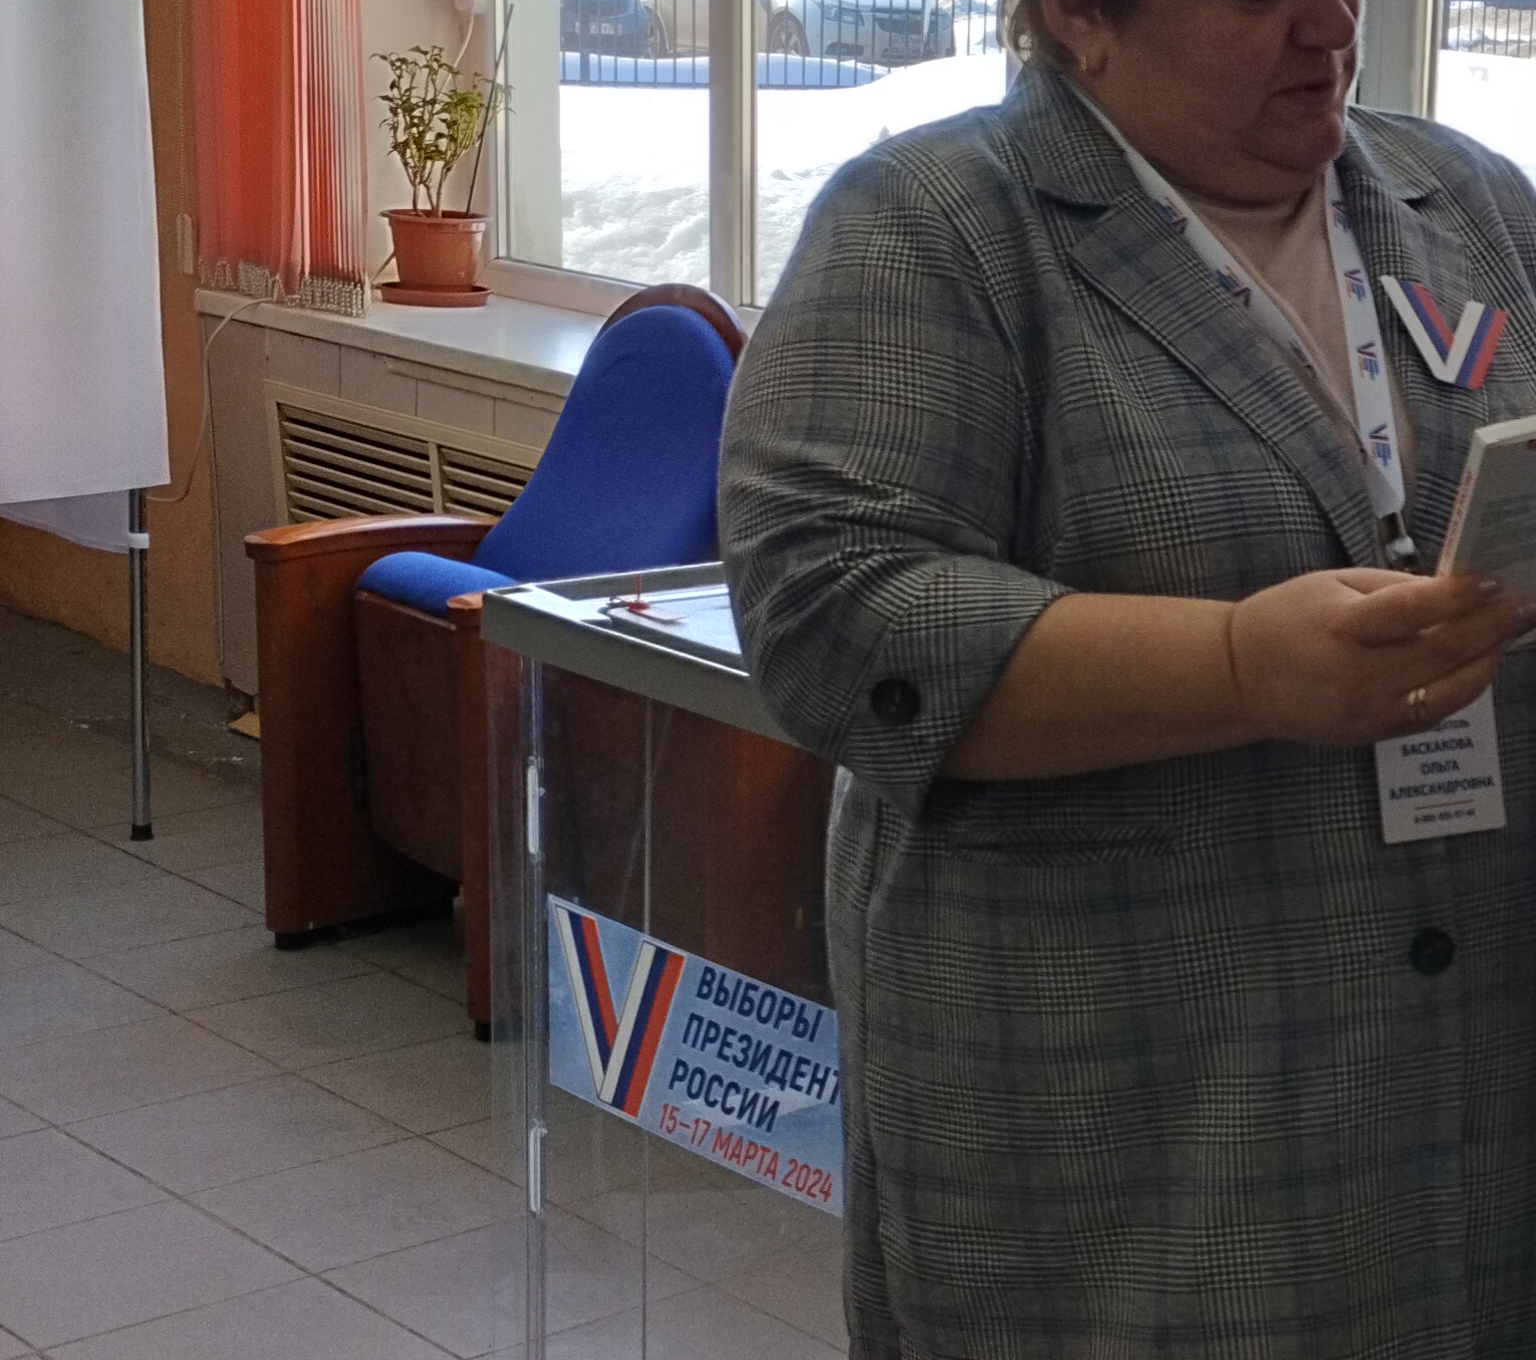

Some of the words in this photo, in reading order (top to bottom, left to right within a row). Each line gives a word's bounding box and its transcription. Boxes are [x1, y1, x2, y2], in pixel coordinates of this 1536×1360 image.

[1389, 776, 1495, 801] АЛЕКСАНДРОВНА
[1420, 759, 1460, 775] ОЛЬГА
[695, 965, 824, 1043] ВЫБОРЫ
[668, 1059, 780, 1133] РОССИИ
[681, 1013, 840, 1106] ПРЕЗИДЕНТ
[658, 1103, 711, 1147] 15-17
[712, 1127, 780, 1181] МАРТА
[782, 1159, 832, 1203] 2024
